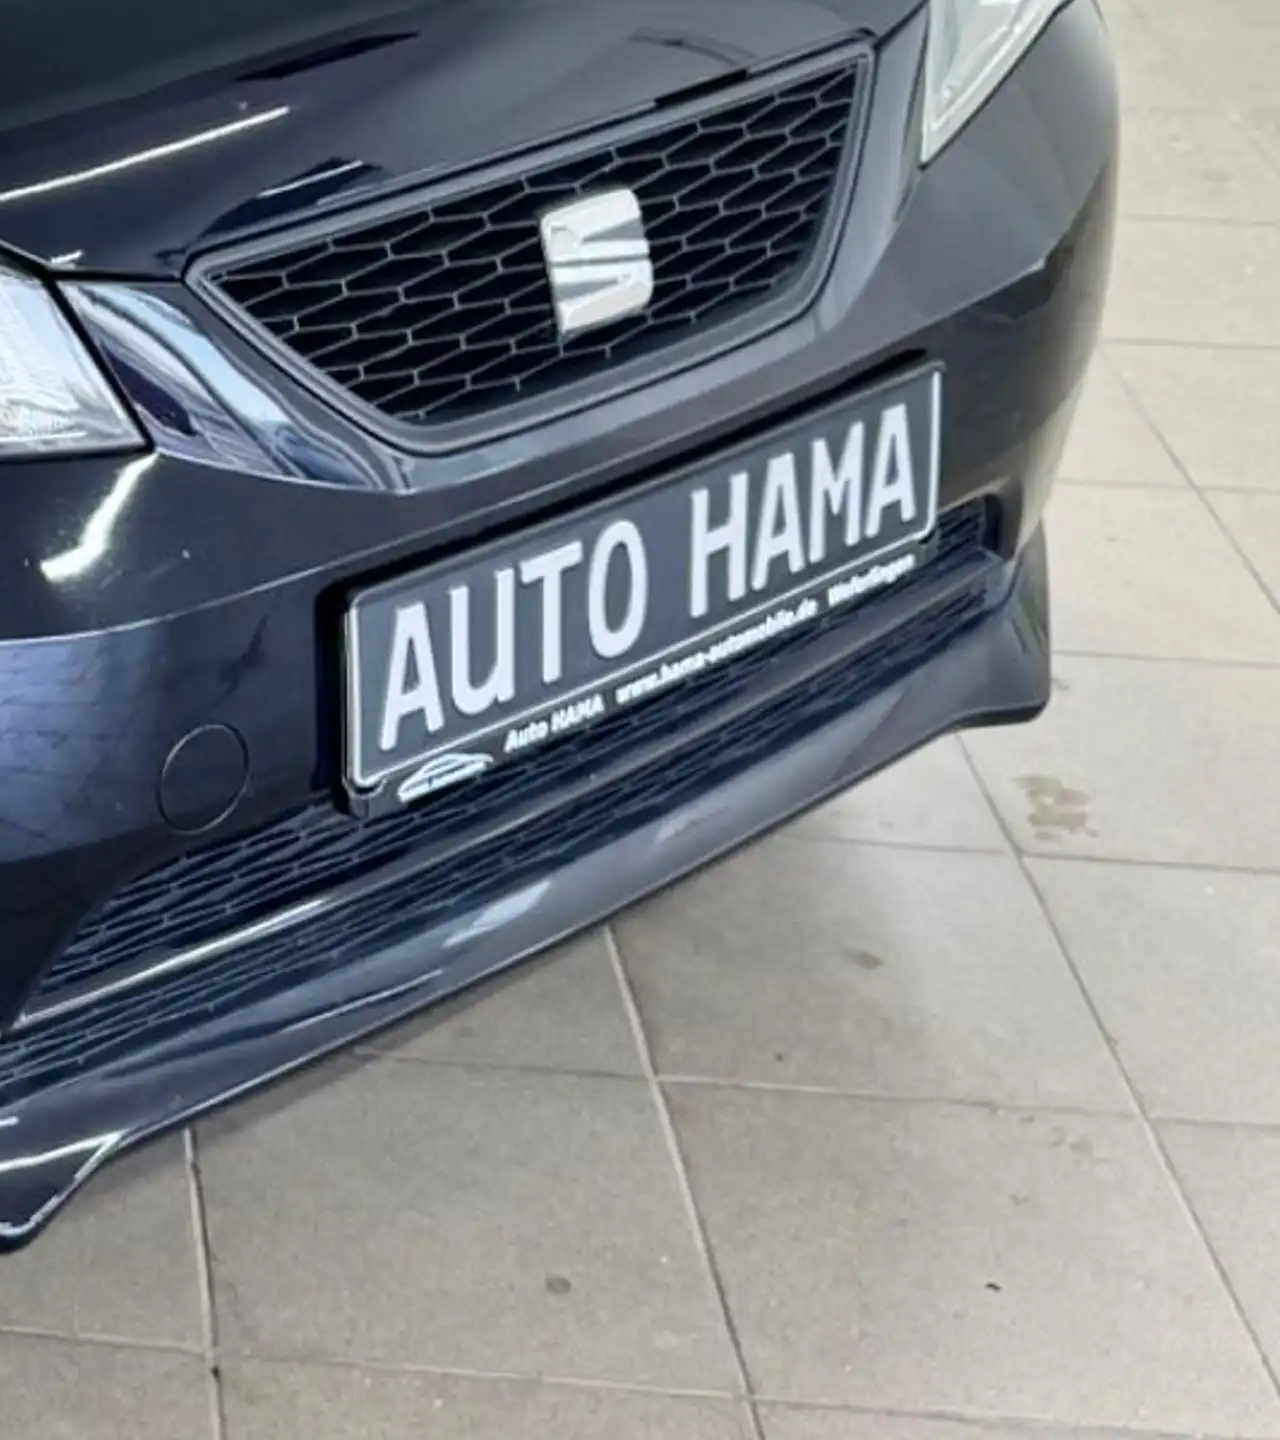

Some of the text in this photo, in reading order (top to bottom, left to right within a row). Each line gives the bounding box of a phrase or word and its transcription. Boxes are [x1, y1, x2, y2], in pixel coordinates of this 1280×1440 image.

[380, 402, 917, 752] AUTO HAMA
[502, 720, 549, 753] Auto
[550, 696, 606, 735] HAMA
